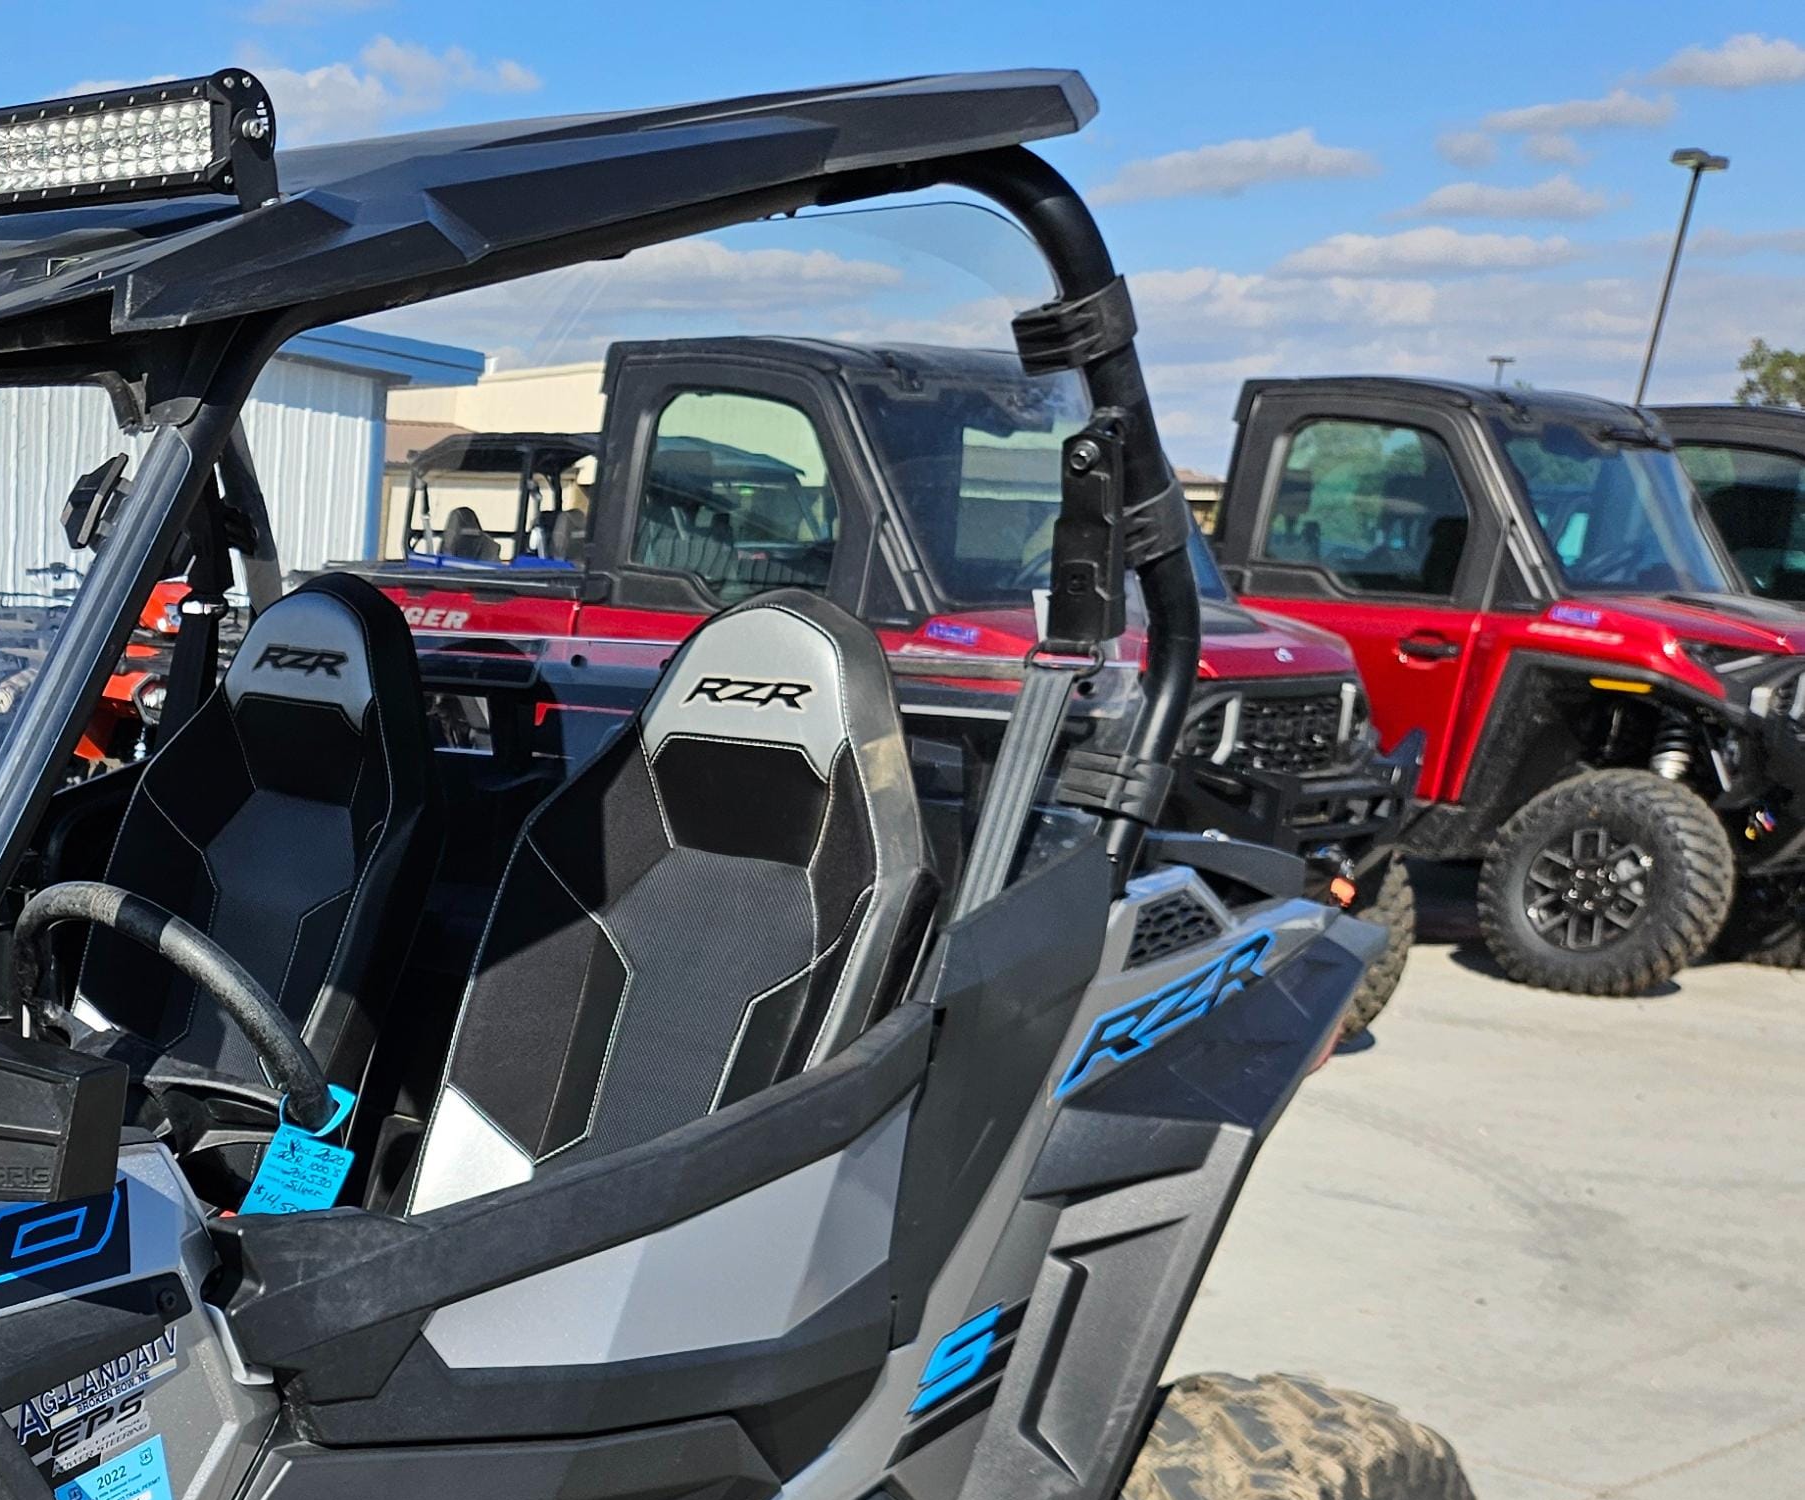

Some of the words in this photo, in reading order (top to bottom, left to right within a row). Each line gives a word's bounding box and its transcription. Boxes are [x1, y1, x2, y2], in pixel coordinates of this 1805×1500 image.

[252, 643, 349, 678] RZR
[681, 675, 814, 711] RZR
[1052, 928, 1276, 1100] RZR
[907, 1302, 1005, 1416] S
[76, 1388, 115, 1413] BROKEN
[52, 1391, 144, 1457] EPS
[96, 1465, 127, 1490] 2022
